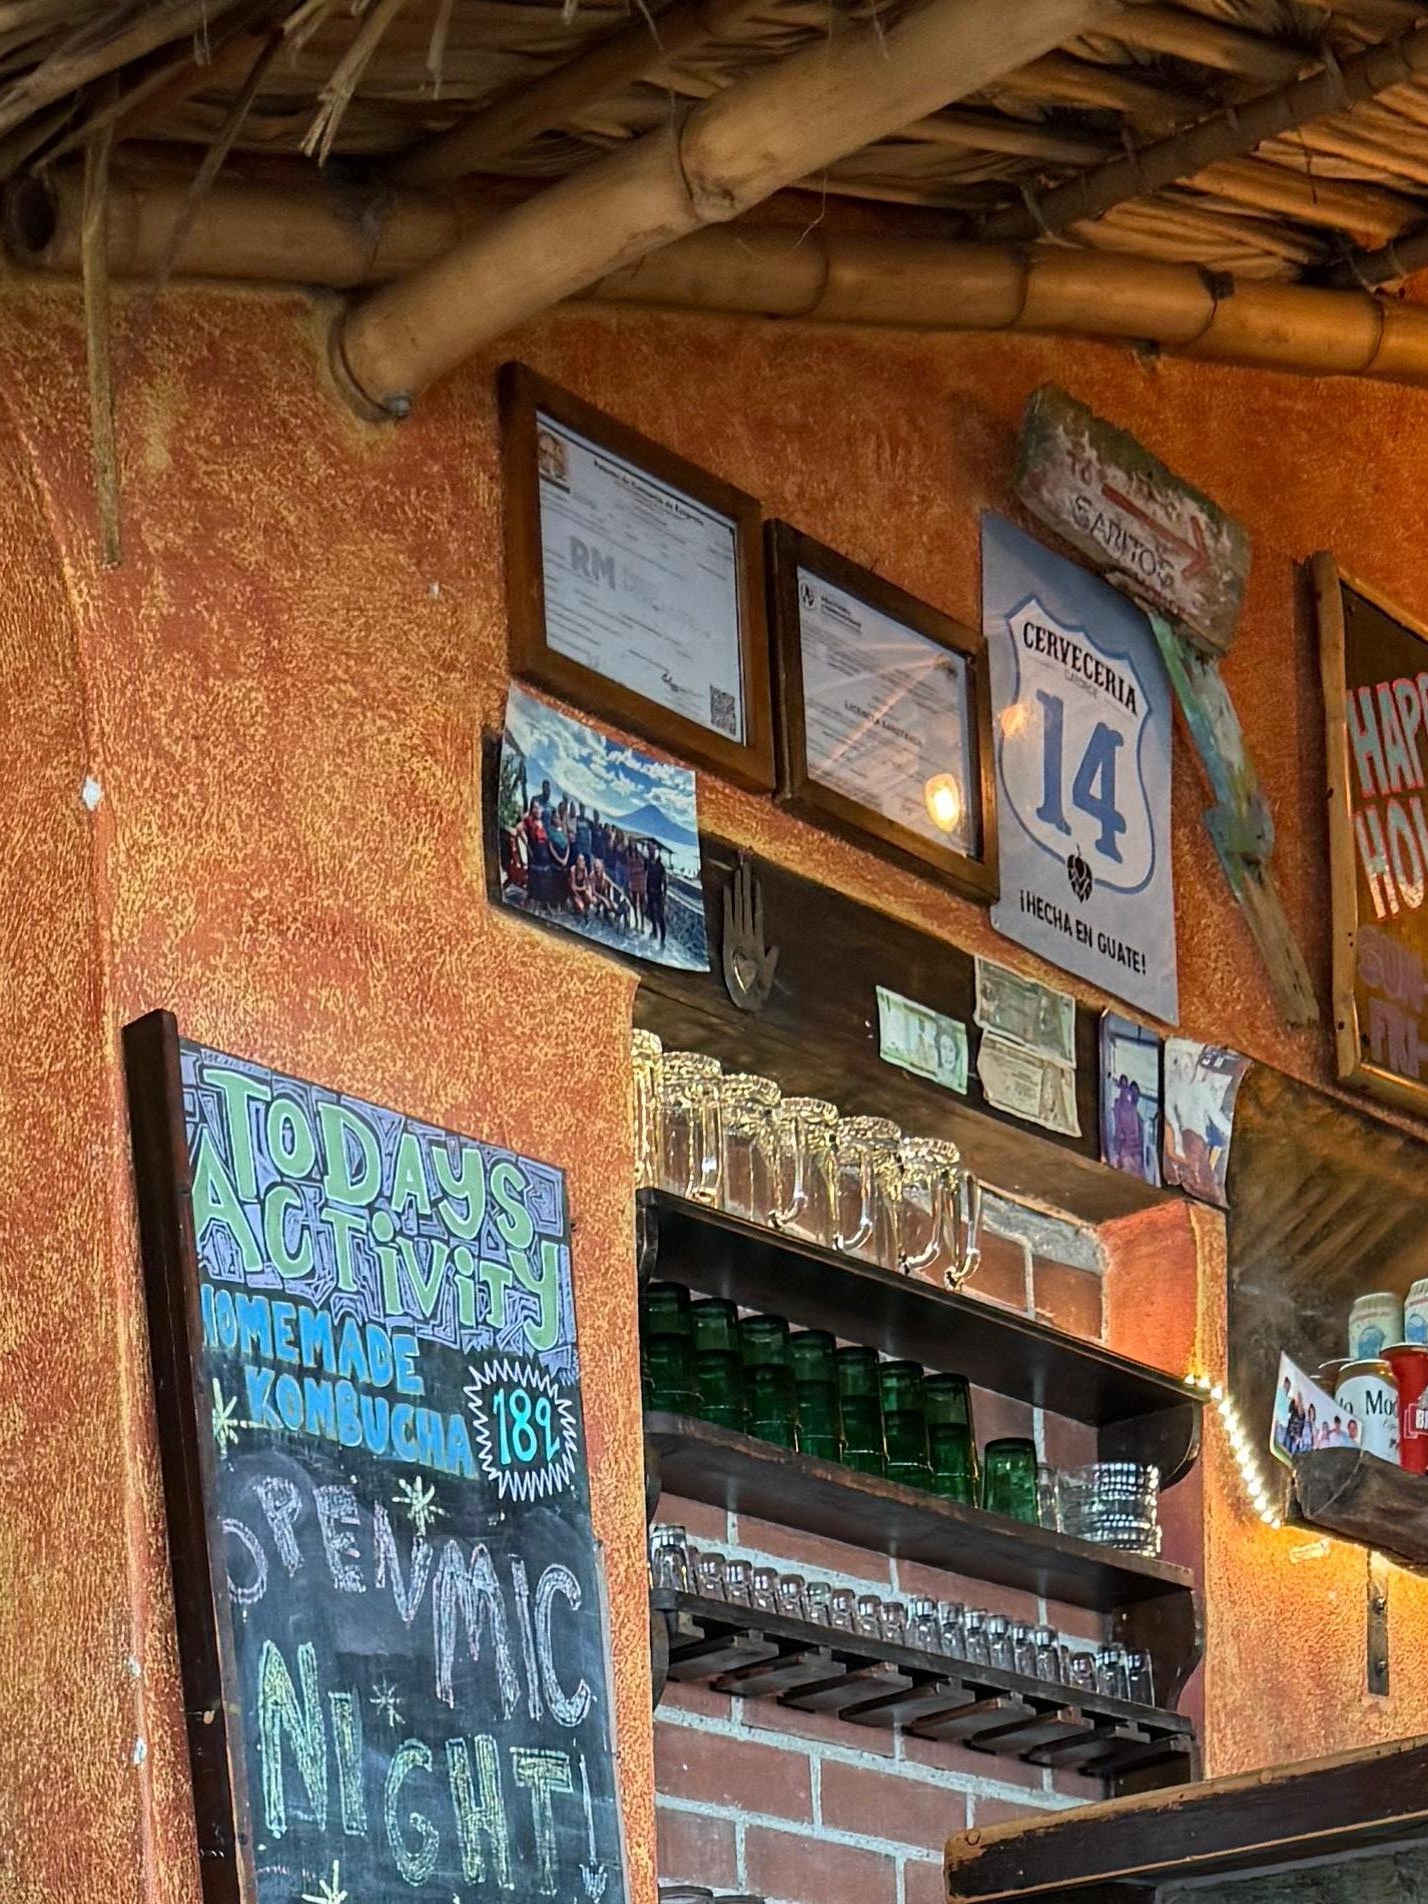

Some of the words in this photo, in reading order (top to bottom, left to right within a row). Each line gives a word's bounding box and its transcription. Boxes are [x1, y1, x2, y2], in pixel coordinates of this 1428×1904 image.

[1023, 621, 1138, 716] CERVECERIA
[1036, 688, 1126, 864] 14
[1076, 920, 1093, 949] EN
[1097, 931, 1146, 976] GUATE!
[203, 1068, 535, 1249] TODAYS
[243, 1365, 480, 1480] KOMBUCHA
[222, 1476, 434, 1630] OPEN
[432, 1539, 591, 1727] MIC
